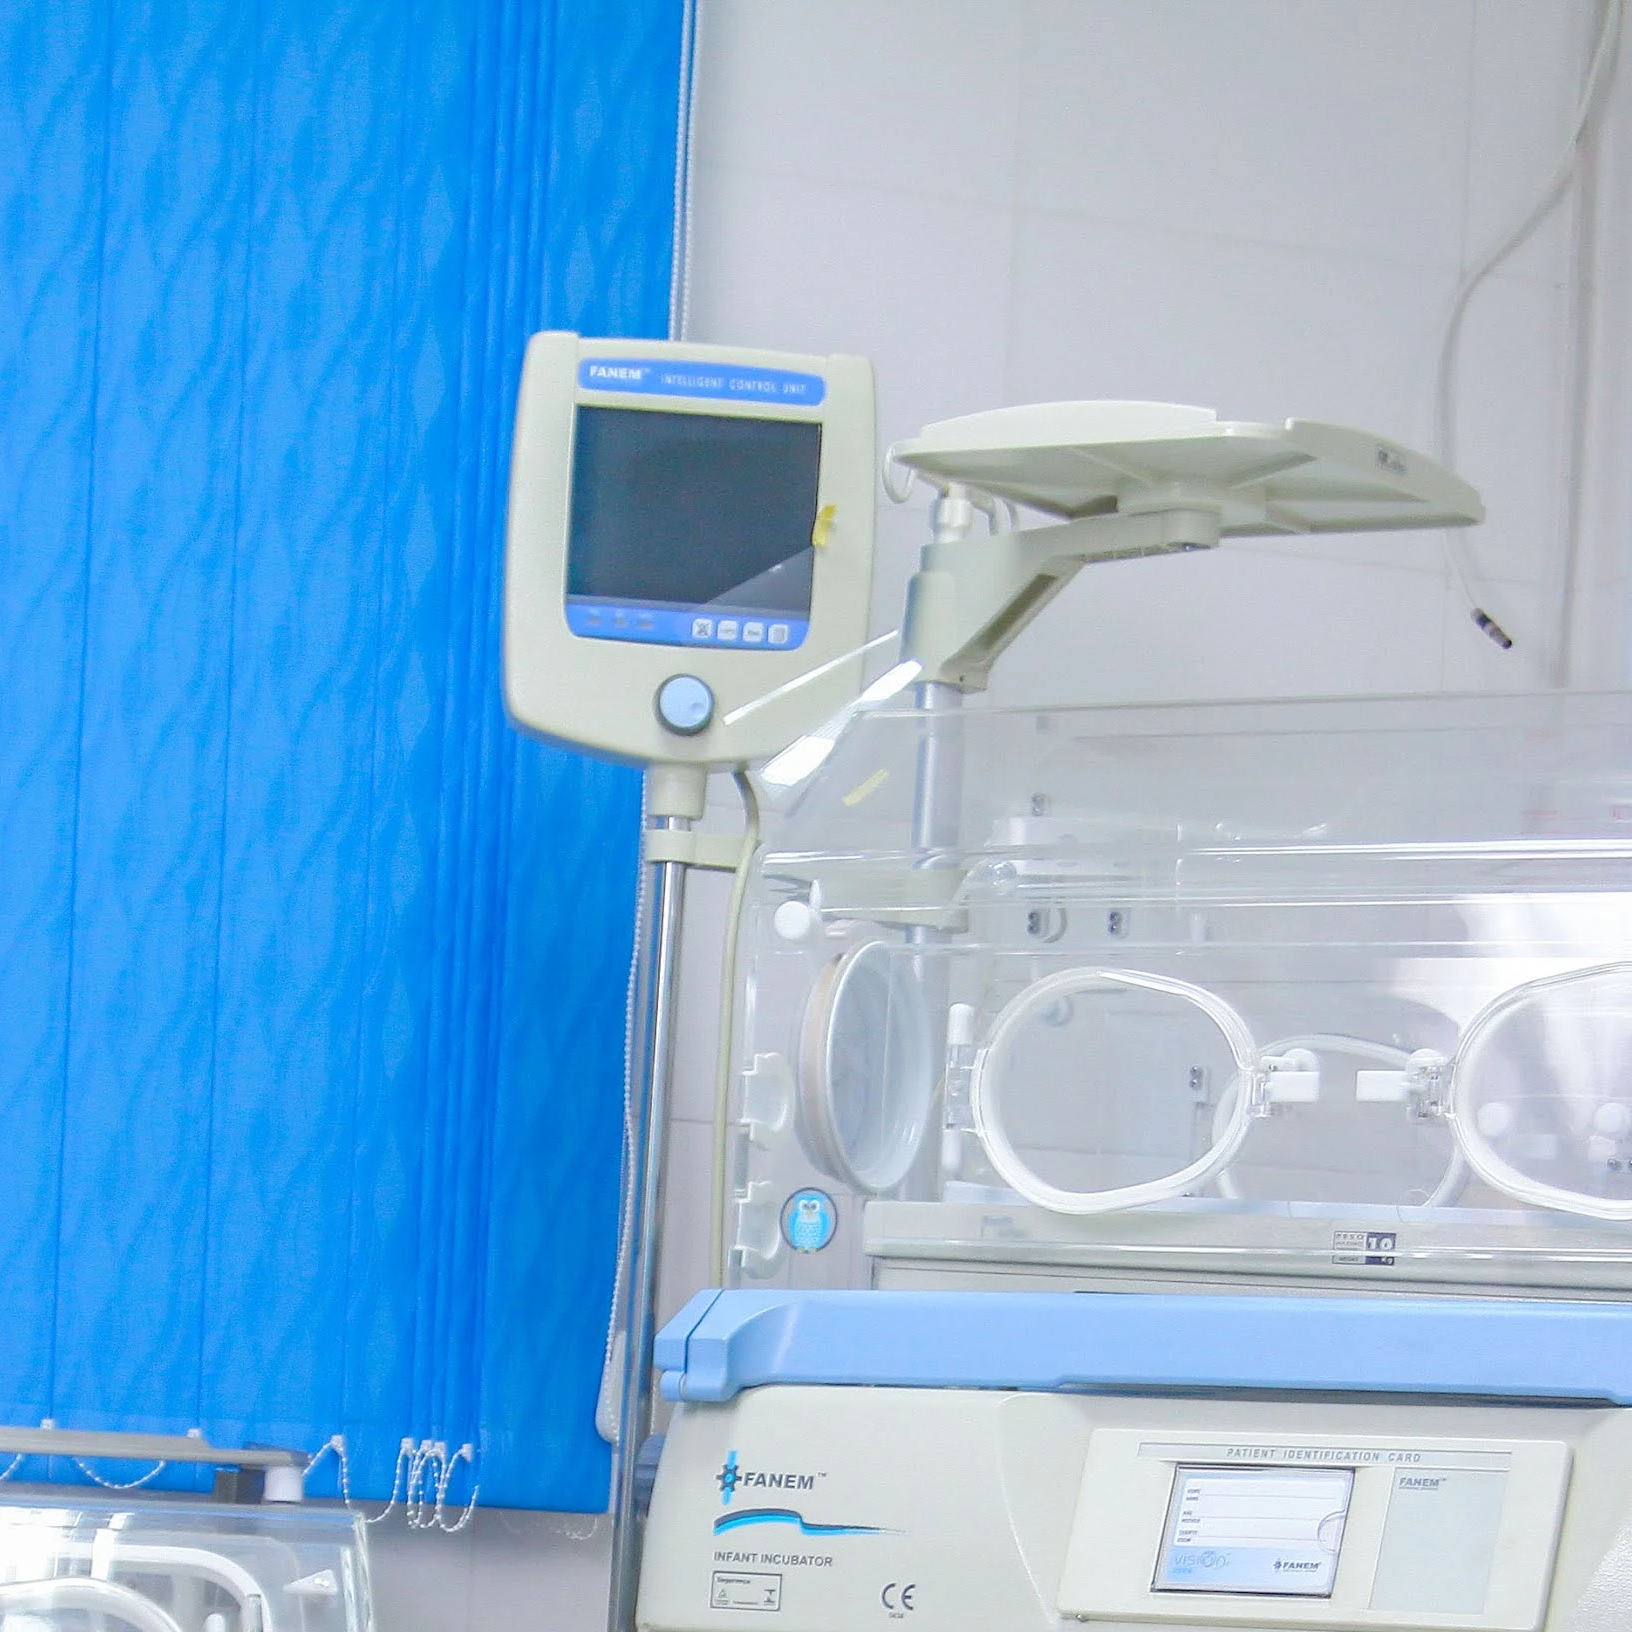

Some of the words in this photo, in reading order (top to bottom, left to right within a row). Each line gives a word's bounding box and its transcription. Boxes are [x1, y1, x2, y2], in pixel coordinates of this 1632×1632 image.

[660, 374, 724, 388] INTELLIGENT
[729, 378, 777, 393] CONTROL
[783, 383, 807, 394] UNIT
[1367, 1237, 1393, 1250] 10
[1226, 1447, 1275, 1459] PATIENT
[1283, 1449, 1380, 1462] IDENTIFICATION
[1388, 1452, 1421, 1463] CARD
[713, 1551, 758, 1565] INFANT
[760, 1553, 833, 1568] INCUBATOR
[881, 1582, 916, 1611] CE
